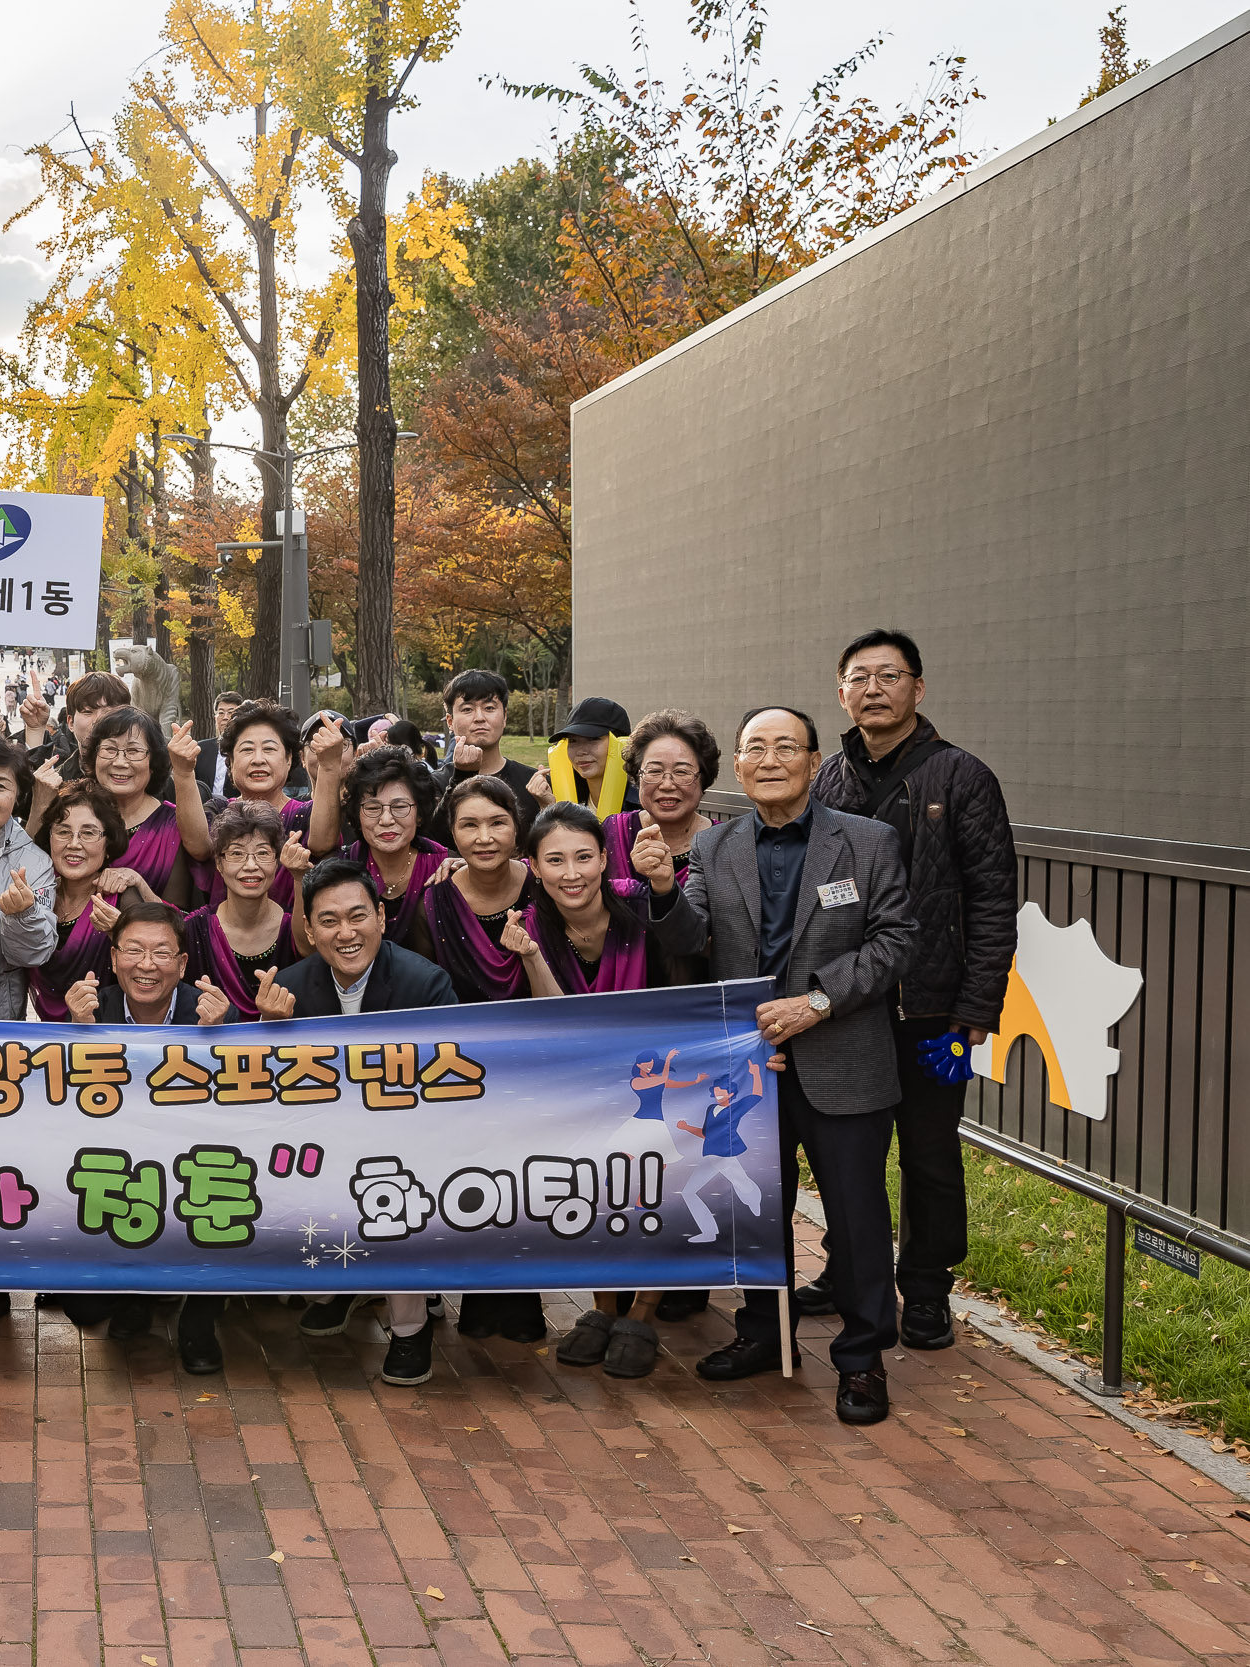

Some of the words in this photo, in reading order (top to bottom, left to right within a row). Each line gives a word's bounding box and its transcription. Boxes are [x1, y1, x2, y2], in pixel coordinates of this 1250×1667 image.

[349, 1151, 665, 1243] 화이팅!!
[1138, 1229, 1165, 1252] 눈으로만
[1167, 1243, 1197, 1266] 봐주세요
